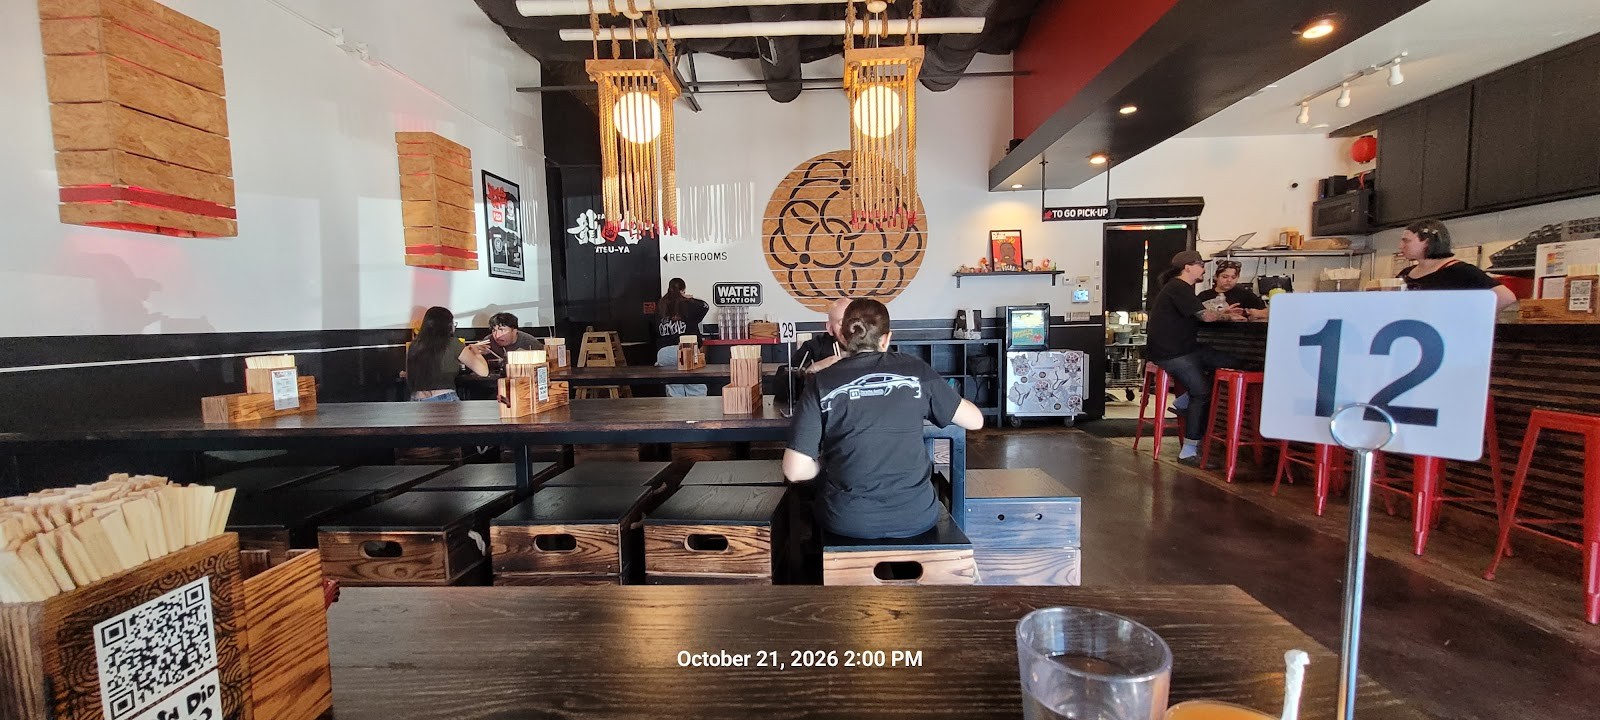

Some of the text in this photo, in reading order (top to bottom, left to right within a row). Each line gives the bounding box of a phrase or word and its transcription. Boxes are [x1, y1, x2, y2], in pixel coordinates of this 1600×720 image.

[1052, 208, 1109, 218] TO GO PICK-UP
[594, 246, 630, 254] ATSU-YA
[669, 252, 728, 262] RESTROOMS
[717, 285, 758, 297] WATER
[782, 322, 794, 338] 29
[1299, 318, 1445, 427] 12
